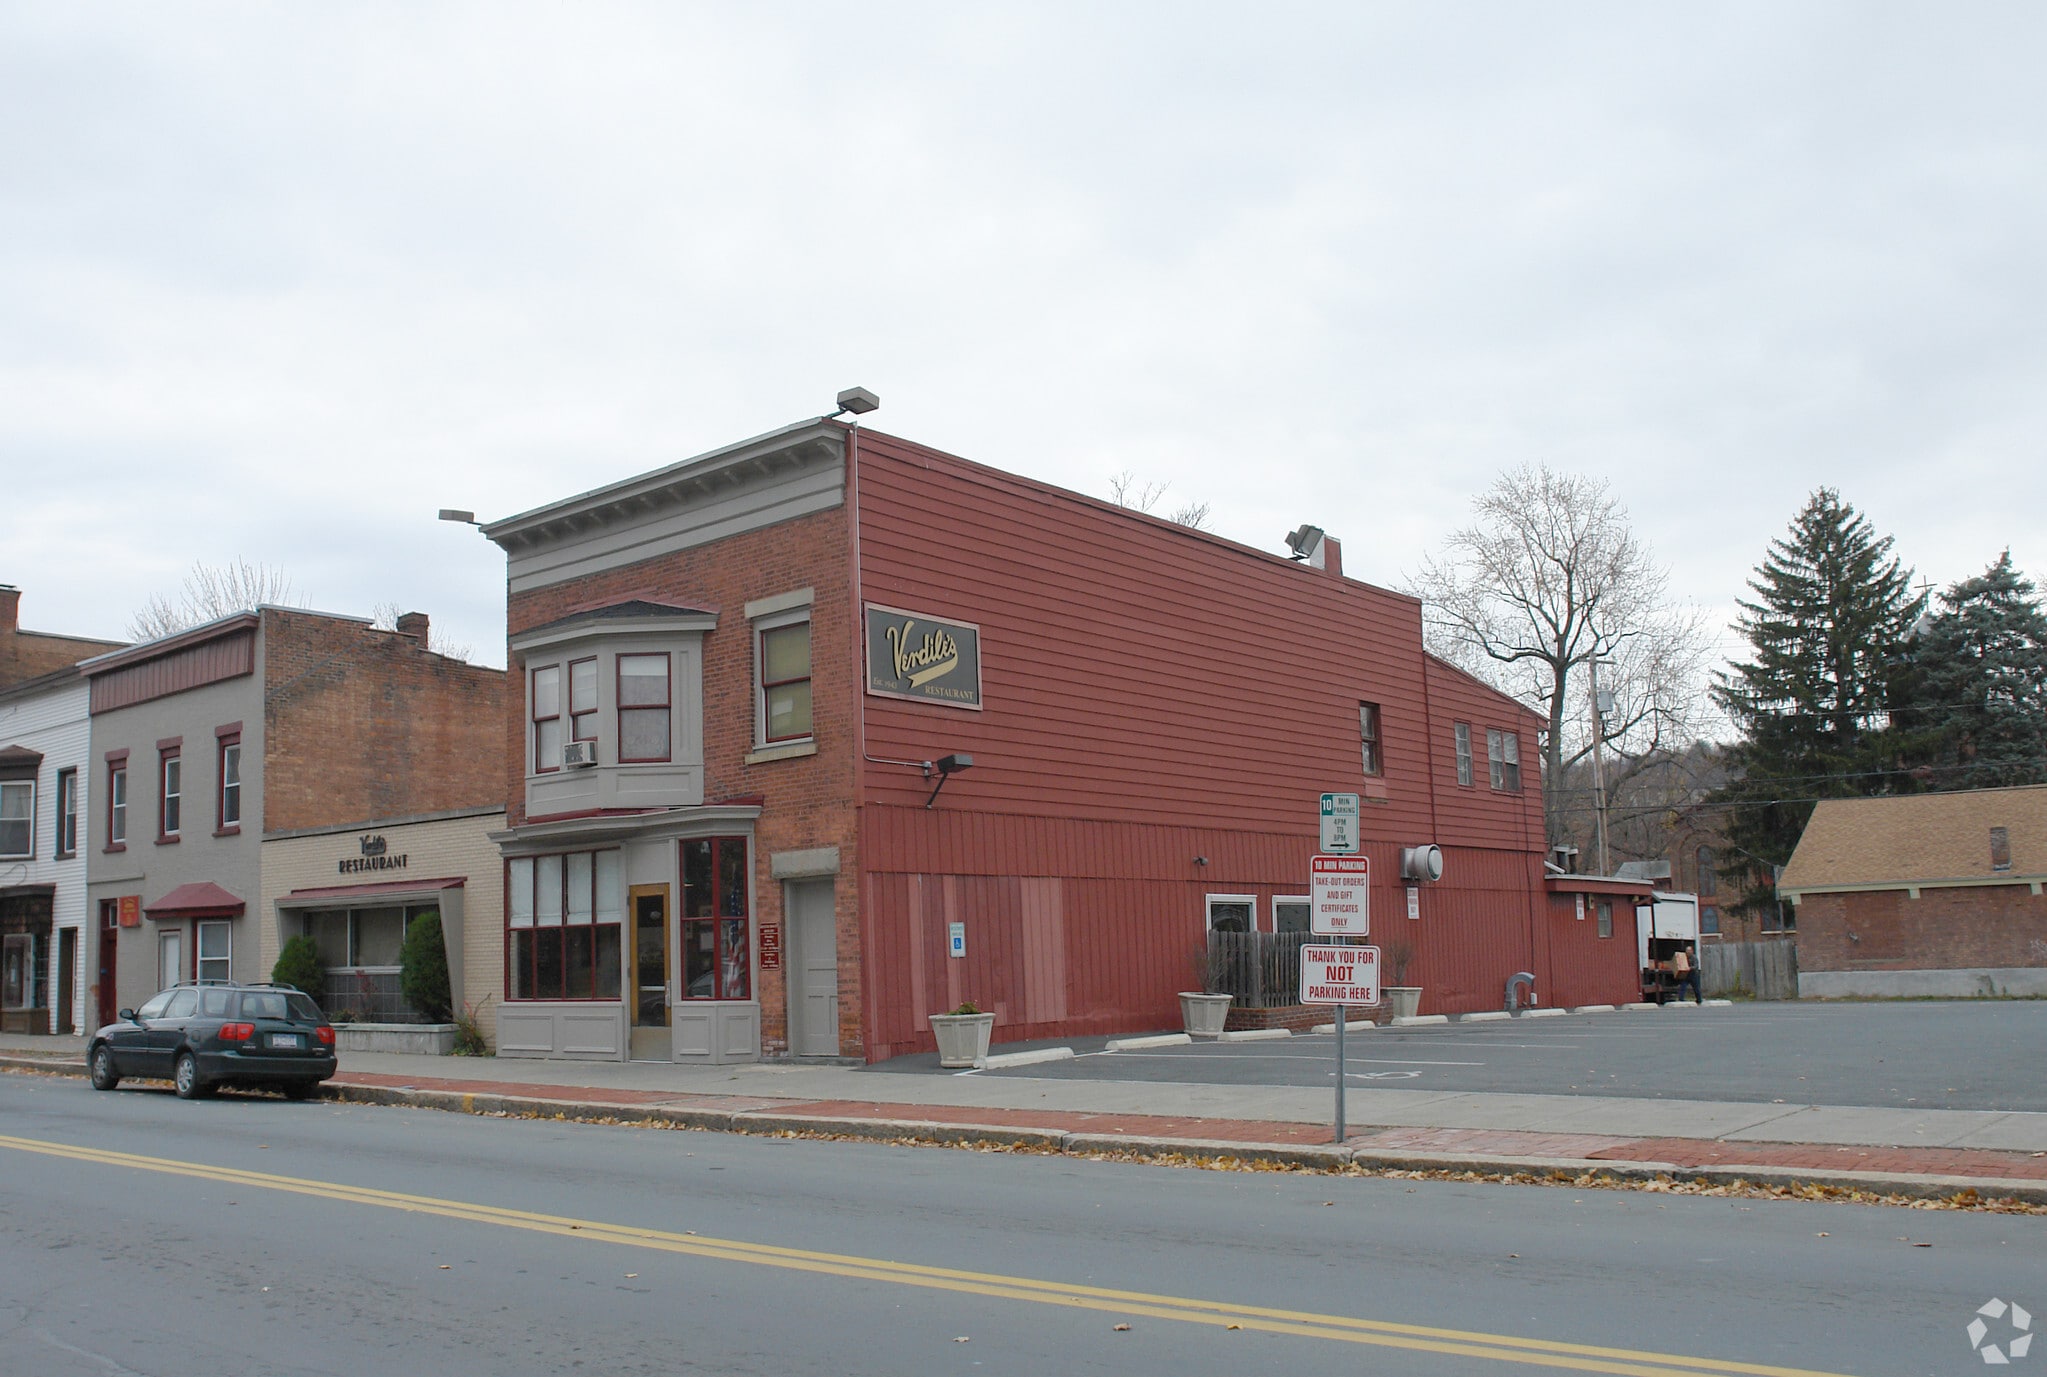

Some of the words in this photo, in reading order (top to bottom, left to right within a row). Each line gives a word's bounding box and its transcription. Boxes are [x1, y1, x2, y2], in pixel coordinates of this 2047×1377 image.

[886, 620, 956, 680] Verdile's
[925, 685, 974, 700] RESTAURANT
[1322, 799, 1332, 811] 10
[1338, 797, 1350, 805] MIN
[1333, 818, 1347, 826] 4PM
[1336, 826, 1344, 834] TO
[339, 854, 408, 873] RESTAURANT
[1314, 860, 1323, 870] 10
[1338, 860, 1366, 871] PARKING
[1315, 877, 1341, 886] TAKE-OUT
[1342, 877, 1365, 887] ORDERS
[1327, 891, 1339, 900] AND
[1340, 891, 1353, 900] GIFT
[1320, 904, 1358, 913] CERTIFICATES
[1330, 917, 1348, 927] ONLY
[1307, 950, 1336, 963] THANK
[1338, 951, 1355, 964] YOU
[1357, 951, 1374, 964] FOR
[1326, 965, 1354, 982] NOT
[1309, 986, 1347, 999] PARKING
[1349, 987, 1371, 1000] HERE
